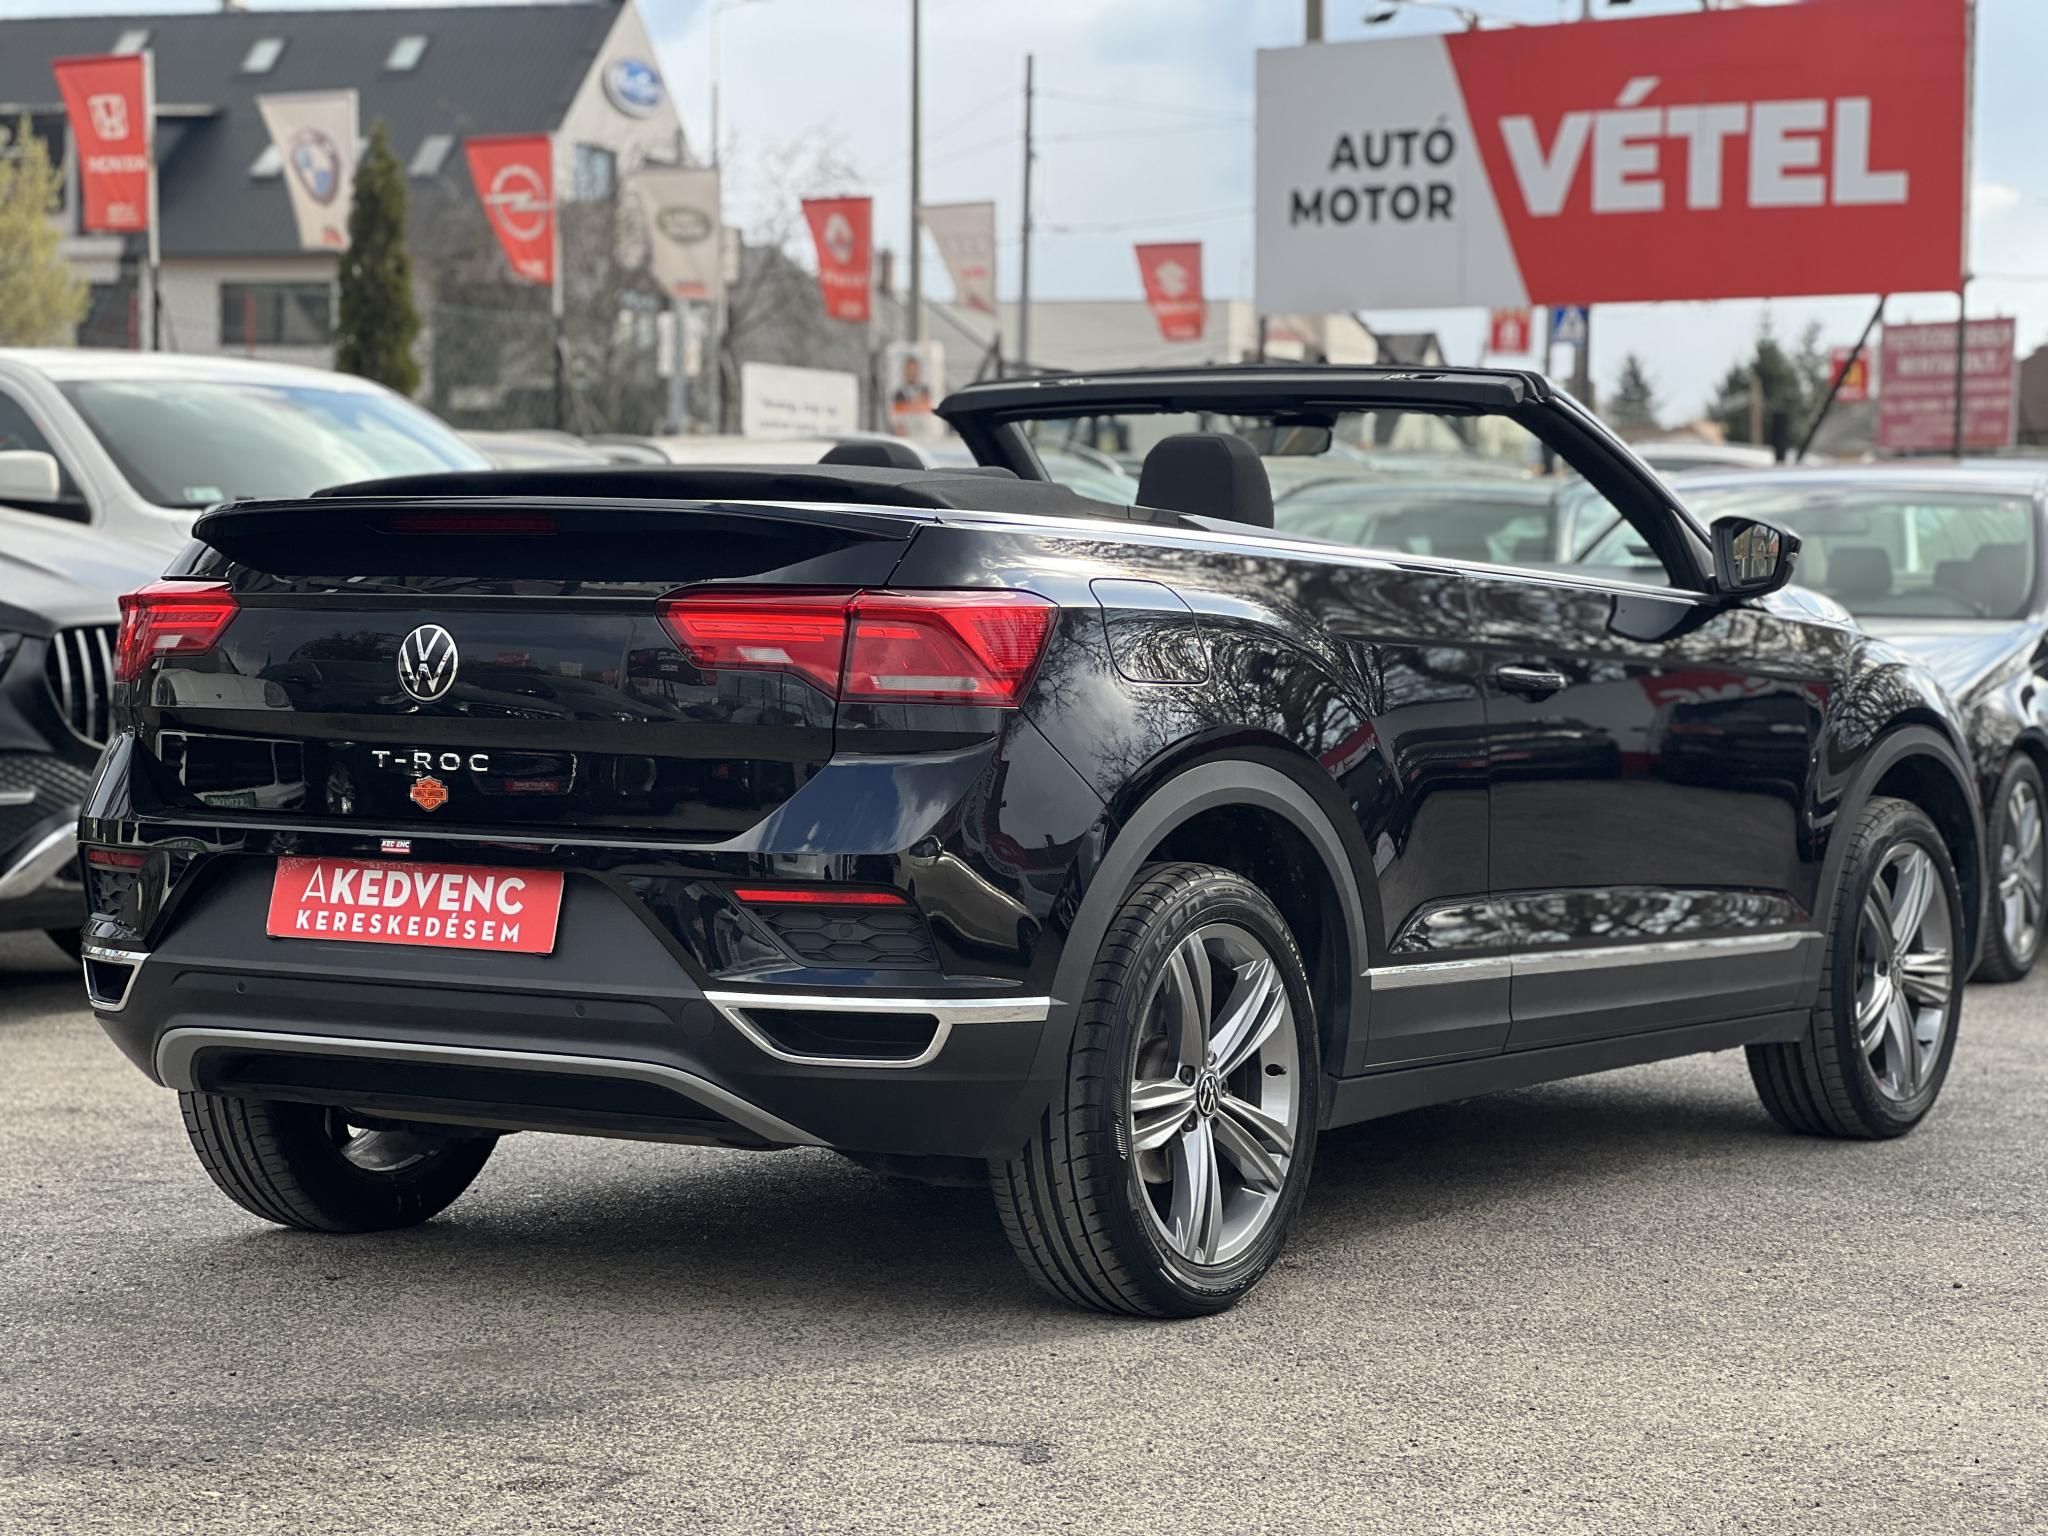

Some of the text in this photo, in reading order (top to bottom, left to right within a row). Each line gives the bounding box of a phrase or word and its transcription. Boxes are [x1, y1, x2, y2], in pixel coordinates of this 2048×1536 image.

[1329, 113, 1454, 171] AUTÓ
[1498, 76, 1908, 217] VÉTEL
[1290, 183, 1454, 226] MOTOR
[371, 750, 489, 771] T-ROC
[301, 864, 526, 915] AKEDVENC
[296, 909, 520, 943] KERESKEDÉSEM
